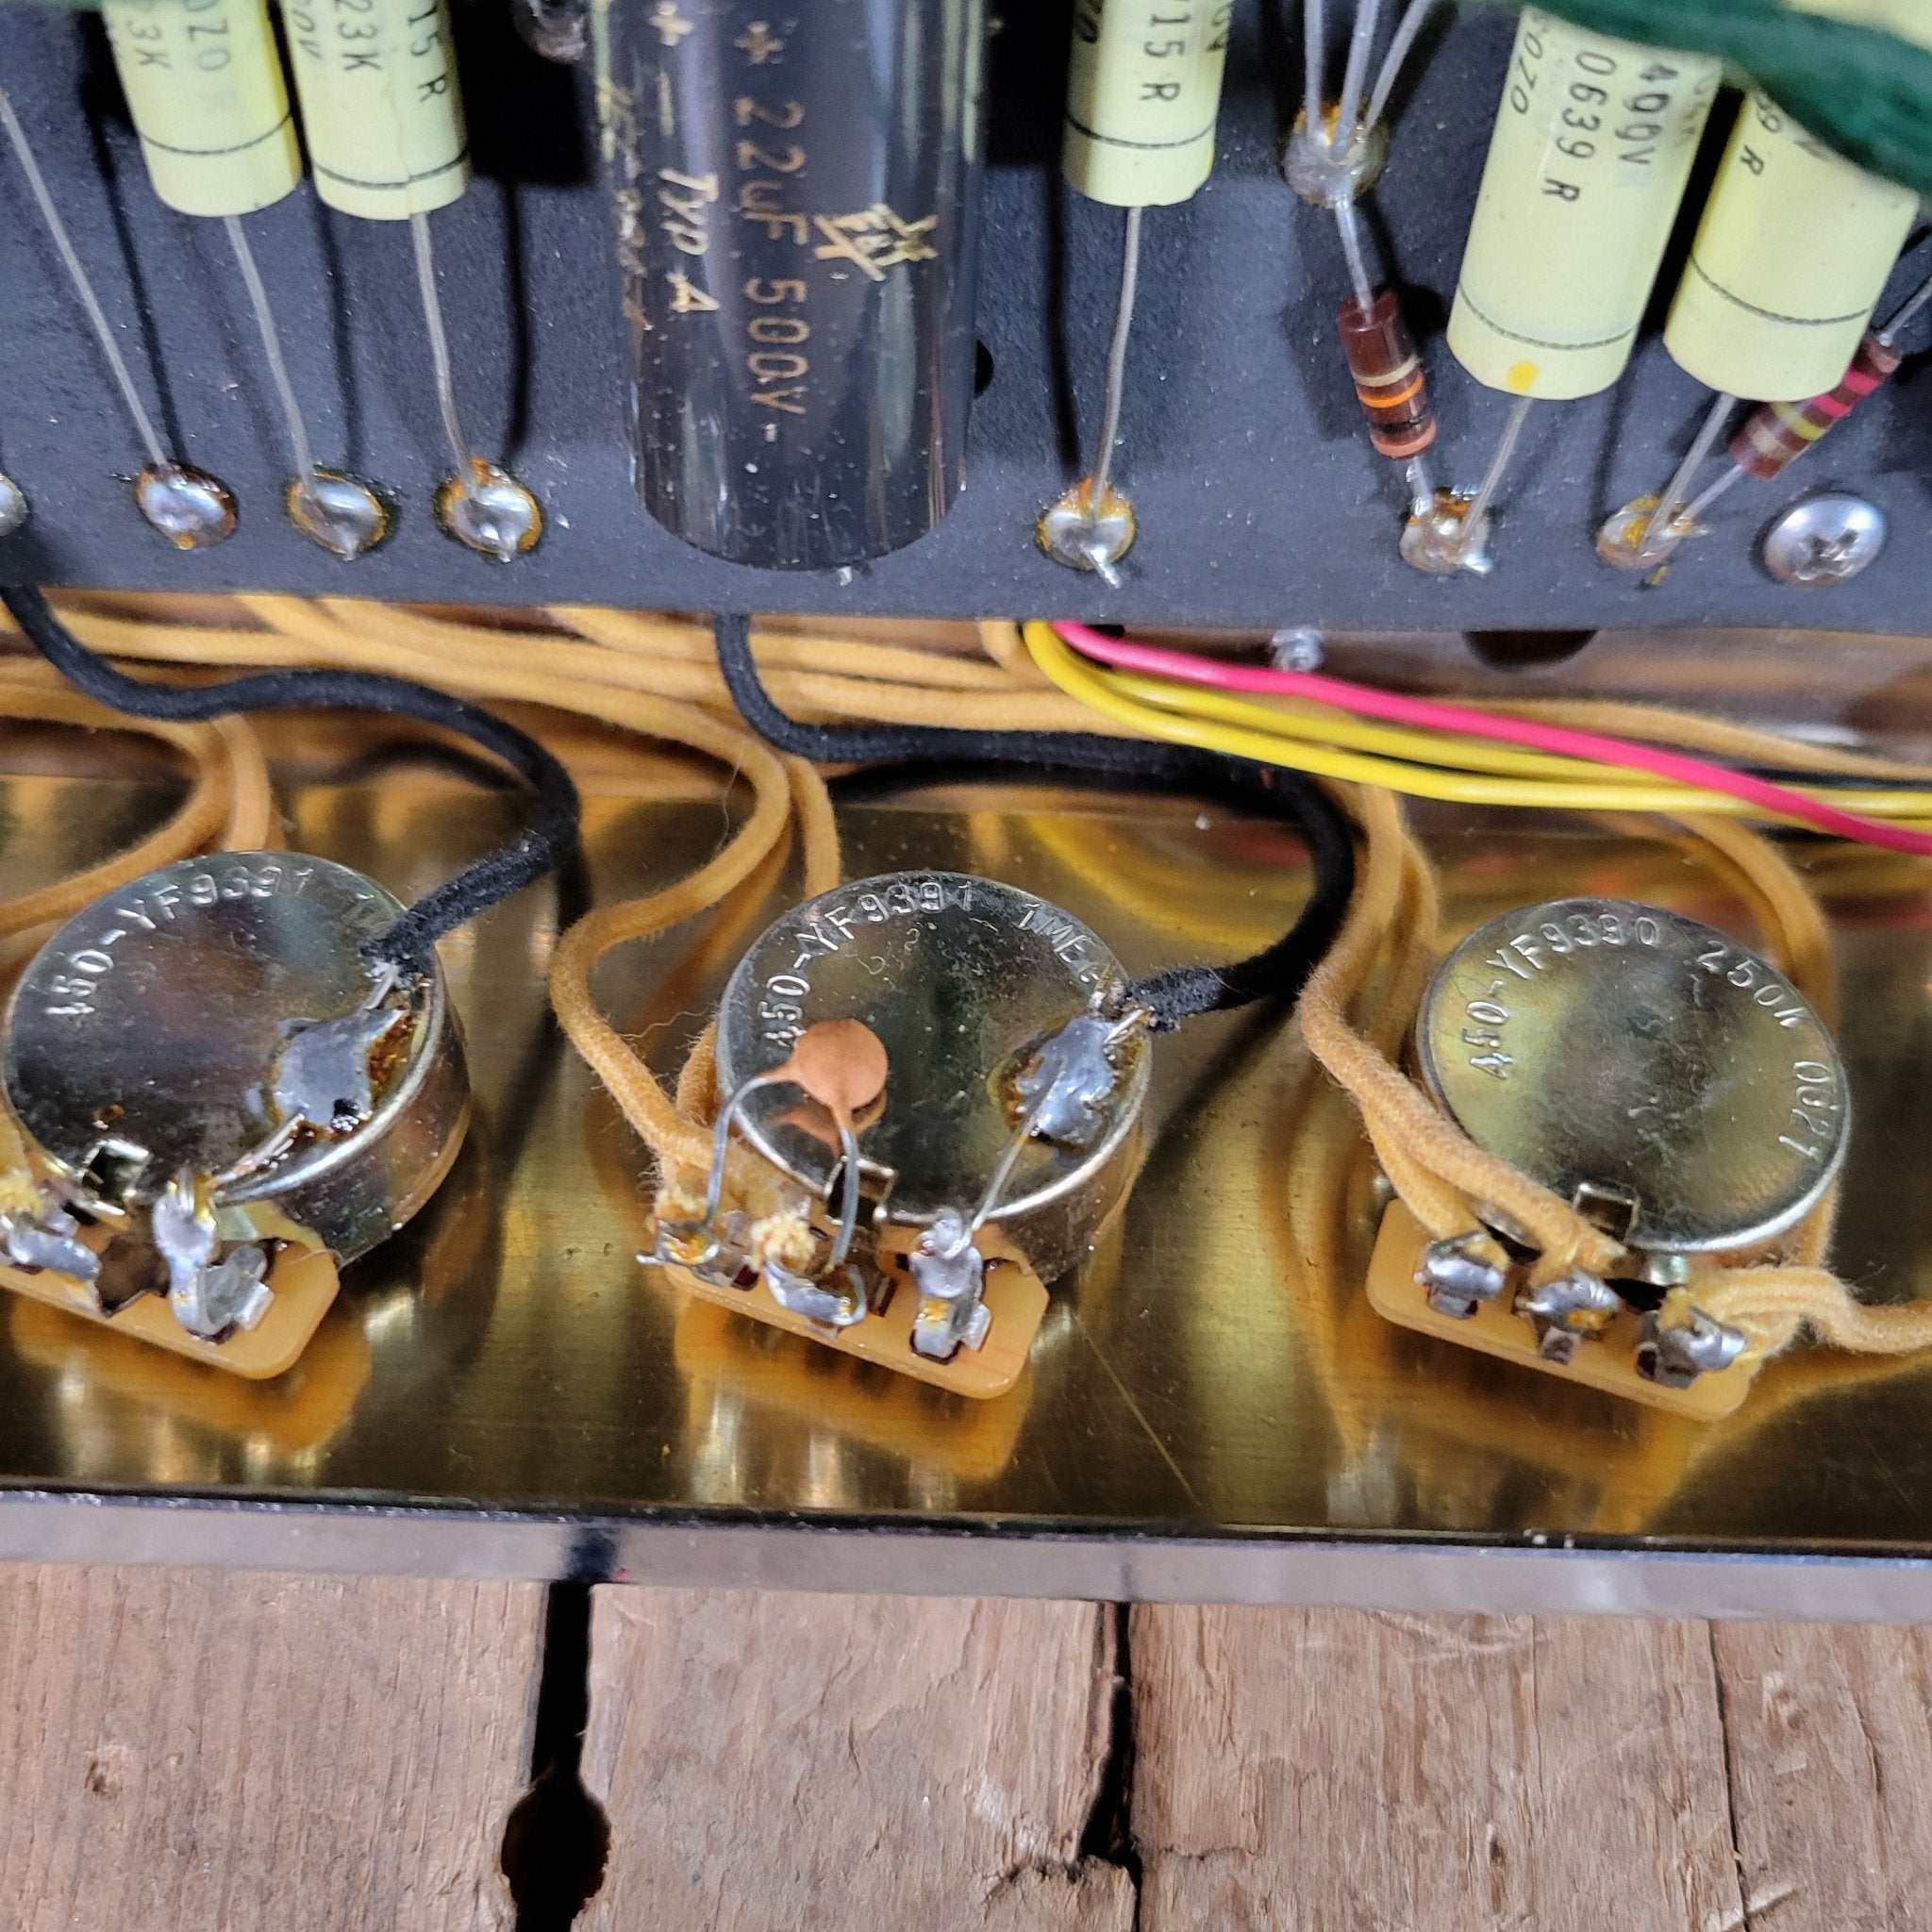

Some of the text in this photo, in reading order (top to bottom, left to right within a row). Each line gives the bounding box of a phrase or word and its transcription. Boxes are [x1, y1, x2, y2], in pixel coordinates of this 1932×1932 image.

[416, 73, 448, 102] R
[1140, 82, 1181, 102] R
[1541, 51, 1618, 203] 0639 R
[1740, 145, 1765, 176] R
[658, 168, 721, 313] Typ A
[742, 278, 811, 415] 500V
[1696, 938, 1813, 1029] 250K
